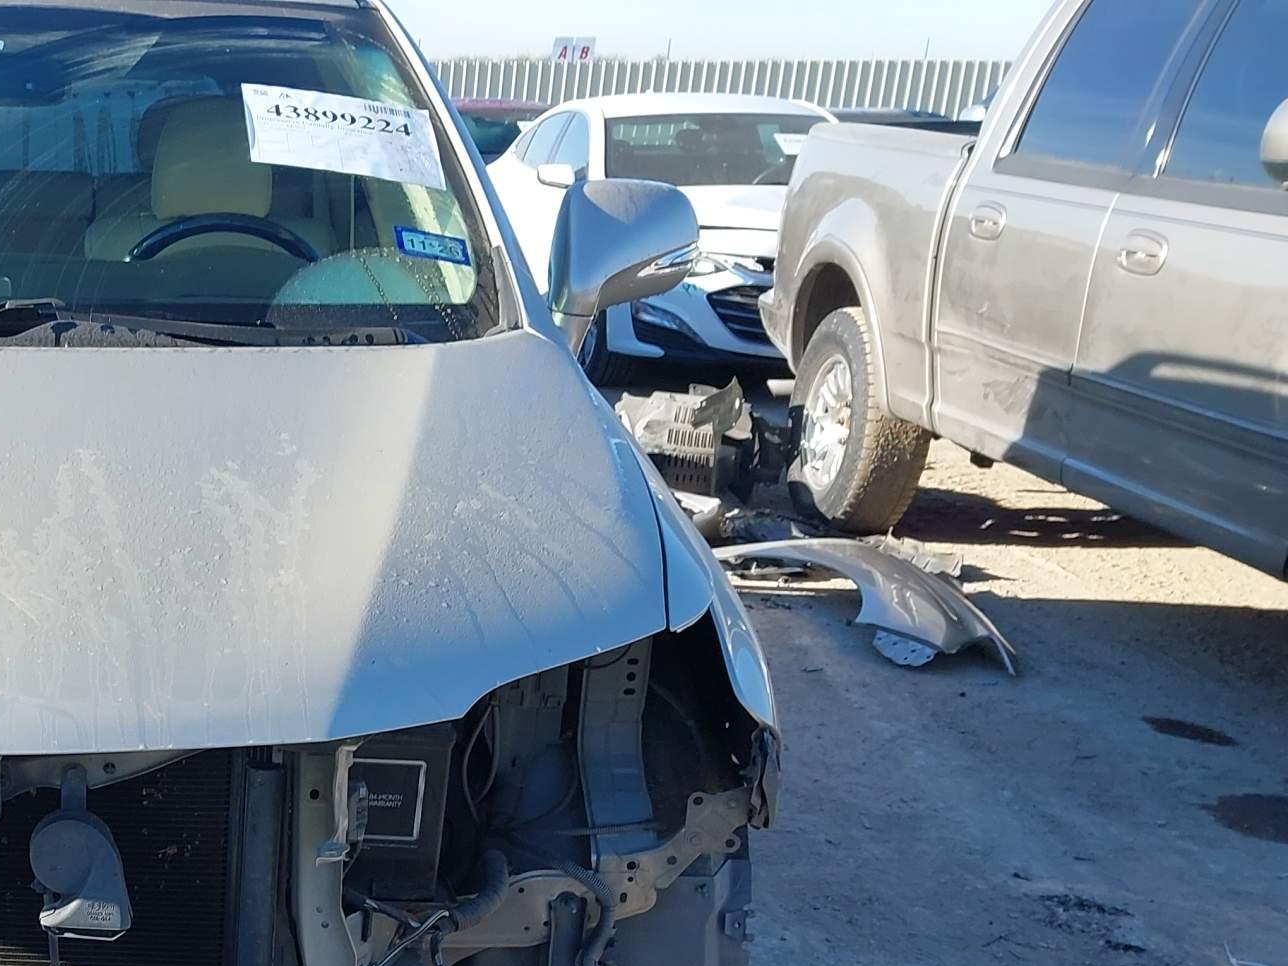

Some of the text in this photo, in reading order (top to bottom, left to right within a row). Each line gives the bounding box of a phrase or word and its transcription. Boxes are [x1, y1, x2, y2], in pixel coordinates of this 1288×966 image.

[558, 45, 590, 60] A B
[267, 103, 413, 137] 43899224
